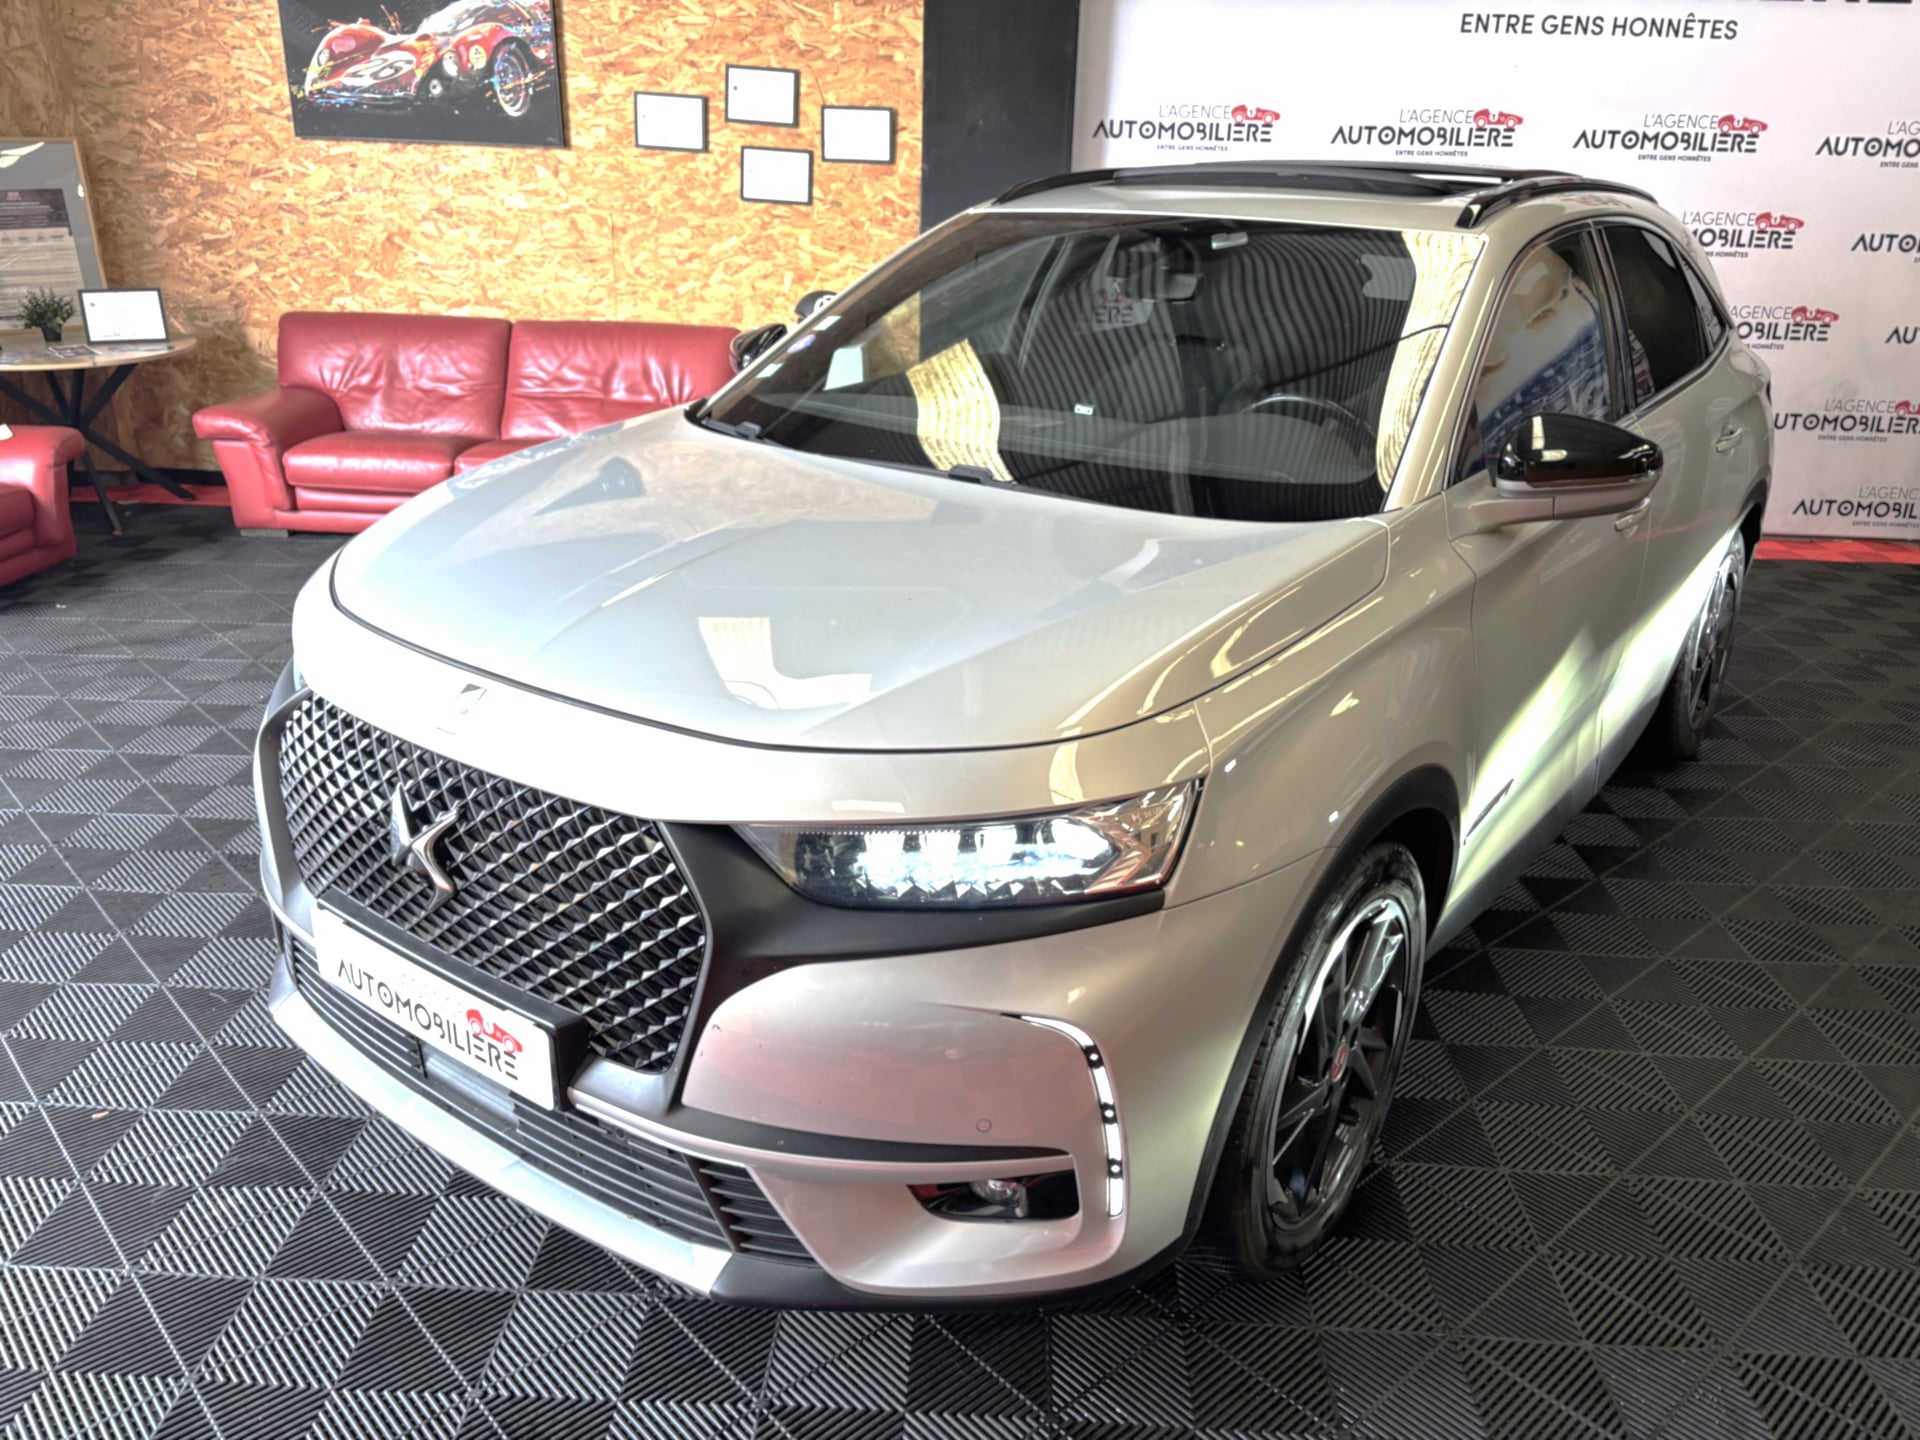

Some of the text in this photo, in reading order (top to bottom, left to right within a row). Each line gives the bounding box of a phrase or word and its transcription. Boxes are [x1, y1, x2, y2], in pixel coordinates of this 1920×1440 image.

[1460, 12, 1738, 40] ENTRE GENS HONNÊTES
[1159, 104, 1232, 119] L'AGENCE
[1399, 108, 1474, 124] L'AGENCE
[1643, 113, 1719, 130] L'AGENCE
[1682, 211, 1757, 227] L'AGENCE
[1692, 228, 1796, 249] OBILIERE
[1850, 233, 1920, 253] AUTO
[1824, 399, 1896, 414] L'AGENCE
[1774, 412, 1920, 434] UTOMOBILIER
[1858, 485, 1920, 500] L'AGENC
[1792, 499, 1920, 519] AUTOMOBIL
